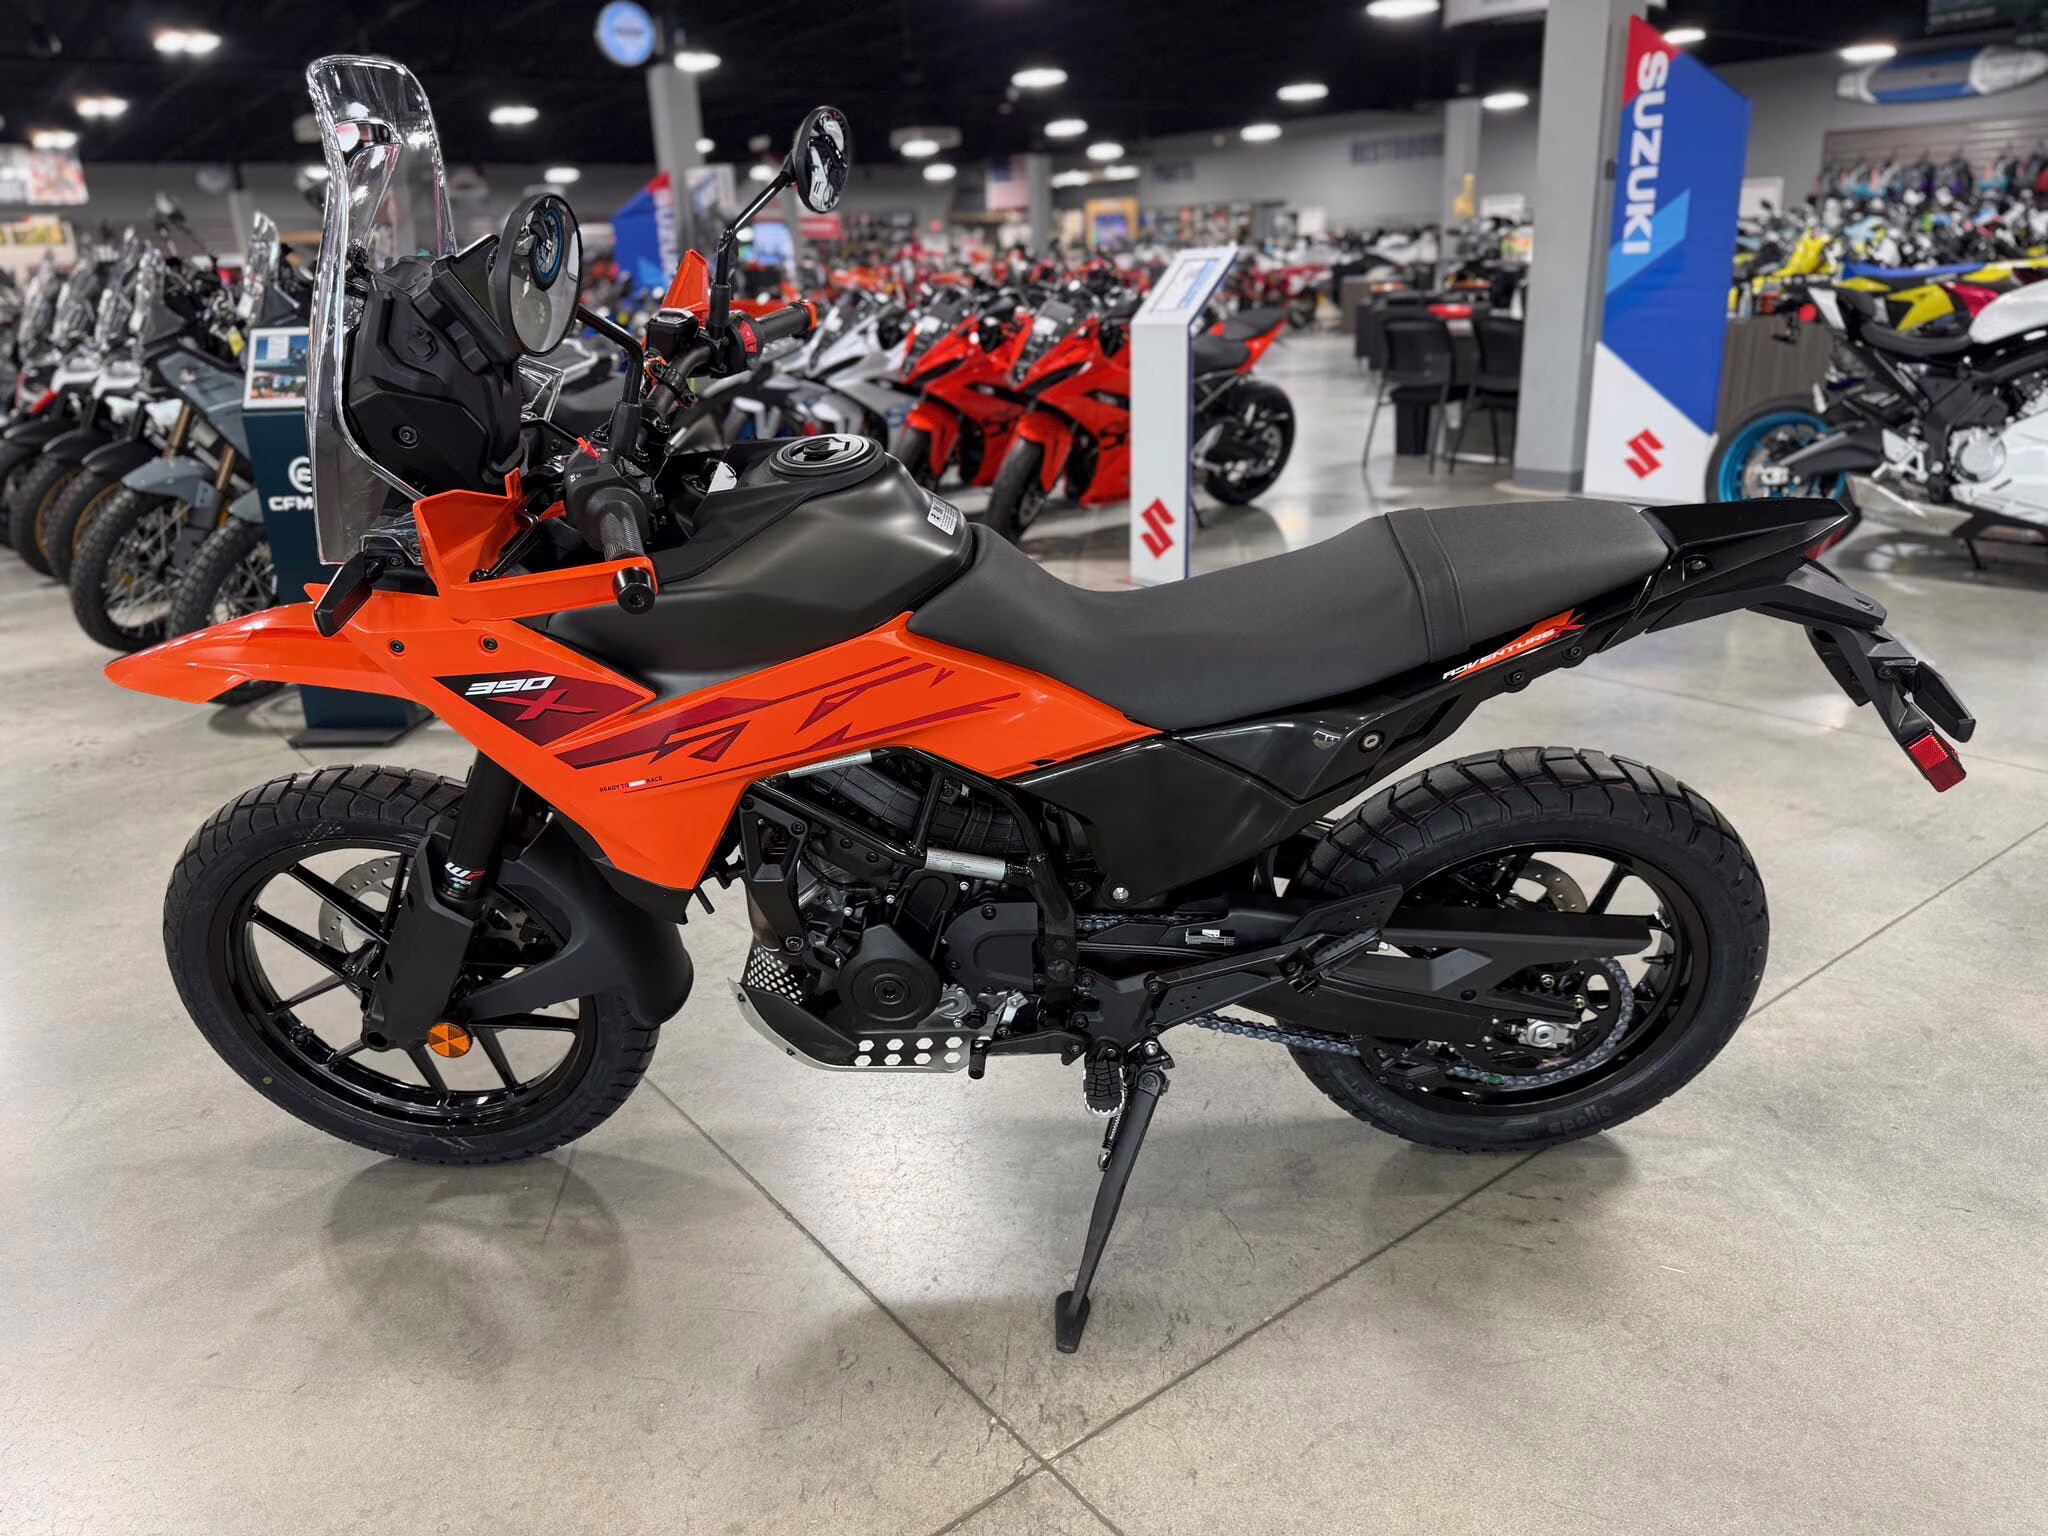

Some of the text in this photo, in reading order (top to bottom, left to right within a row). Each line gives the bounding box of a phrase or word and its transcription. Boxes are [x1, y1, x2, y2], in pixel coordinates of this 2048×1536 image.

[1621, 50, 1670, 255] SUZUKI
[268, 496, 314, 512] CFM
[1442, 627, 1557, 680] ADVENTURE
[464, 675, 557, 696] 390
[487, 688, 600, 722] X
[600, 784, 620, 793] READY
[646, 775, 663, 784] RACE
